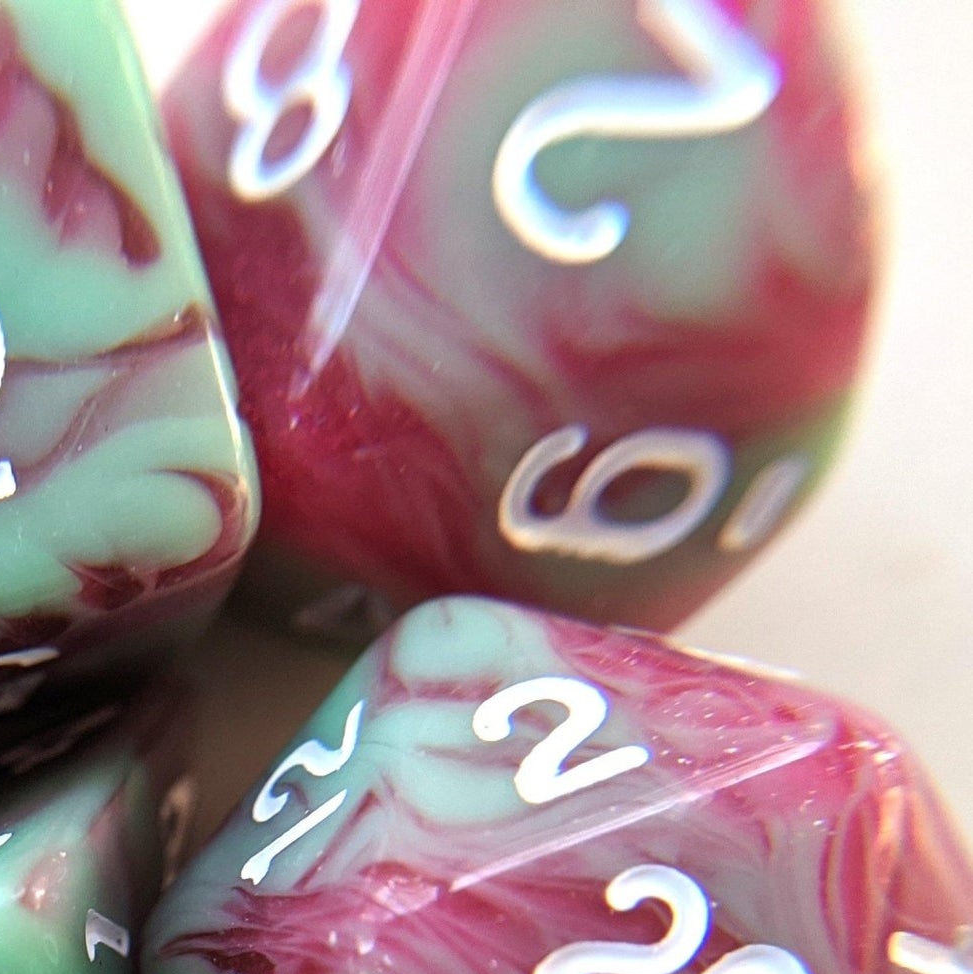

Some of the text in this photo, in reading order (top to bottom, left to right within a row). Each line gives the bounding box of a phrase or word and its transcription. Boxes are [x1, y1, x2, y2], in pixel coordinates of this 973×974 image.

[222, 0, 355, 202] 8
[494, 0, 783, 264] 2
[239, 698, 368, 887] 12
[472, 676, 649, 804] 2
